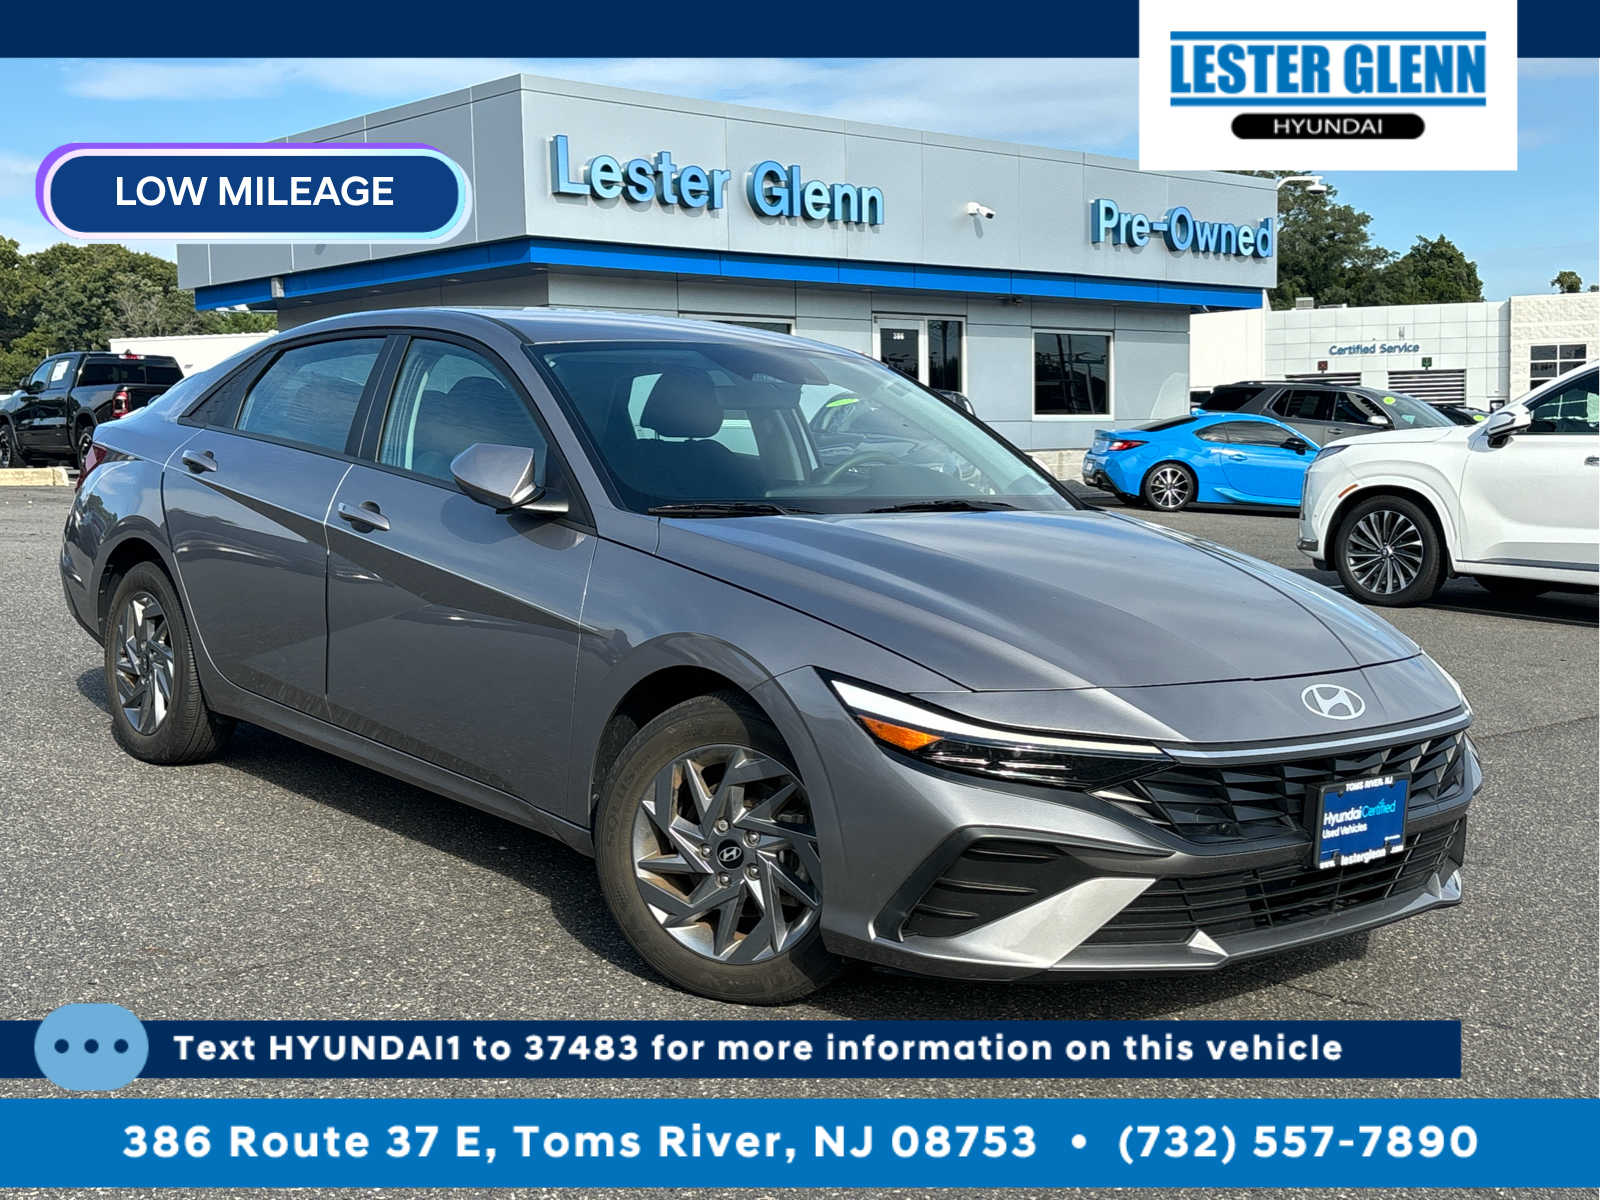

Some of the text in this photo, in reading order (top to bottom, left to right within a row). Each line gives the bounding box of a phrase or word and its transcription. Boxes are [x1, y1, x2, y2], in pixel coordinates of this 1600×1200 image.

[550, 134, 885, 226] Lester Glenn
[1090, 198, 1274, 258] Pre-Owned
[1329, 342, 1420, 355] Certified Service
[1322, 822, 1368, 840] Used Vehicles
